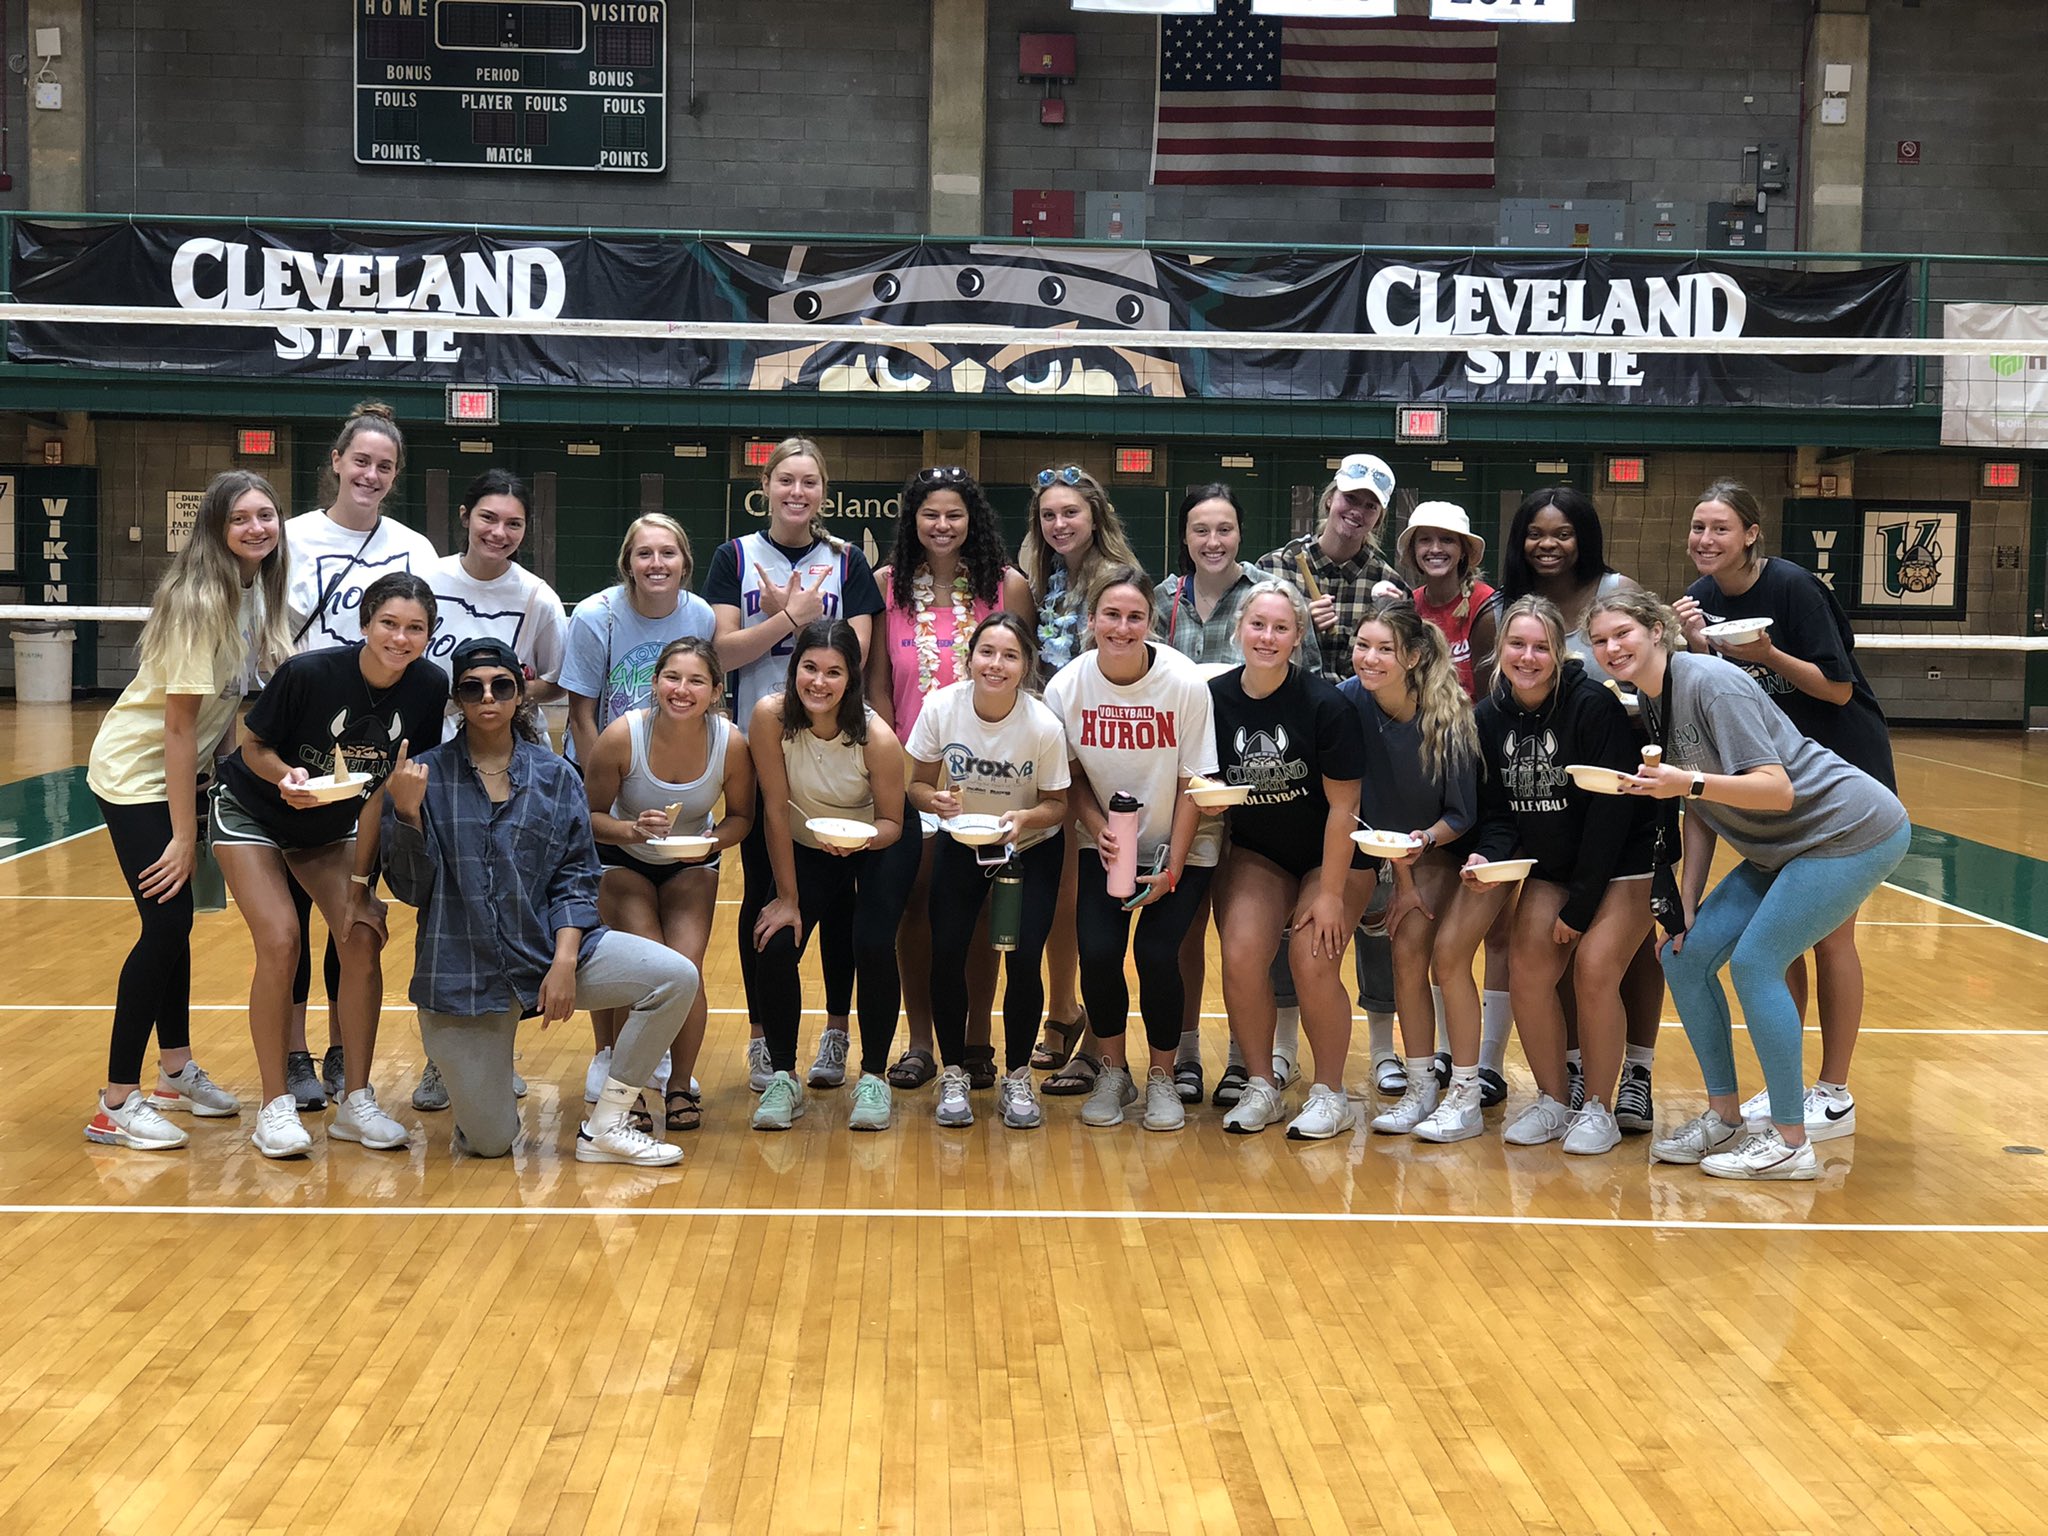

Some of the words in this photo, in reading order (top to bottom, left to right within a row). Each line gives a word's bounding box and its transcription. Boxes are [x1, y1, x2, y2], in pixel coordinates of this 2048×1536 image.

[365, 0, 428, 17] HOME
[591, 4, 660, 24] VISITOR
[386, 64, 432, 82] BONUS
[476, 68, 520, 83] PERIOD
[589, 71, 634, 87] BONUS
[375, 92, 417, 107] FOULS
[461, 94, 513, 111] PLAYER
[525, 96, 567, 112] FOULS
[603, 98, 646, 115] FOULS
[372, 144, 421, 161] POINTS
[486, 147, 532, 164] MATCH
[600, 151, 649, 168] POINTS
[171, 237, 566, 322] CLEVELAND
[1366, 265, 1747, 338] CLEVELAND
[274, 309, 462, 363] STATE
[1465, 344, 1645, 387] STATE
[460, 394, 486, 415] EXIT
[1409, 413, 1436, 433] EXIT
[42, 498, 69, 603] VIKIN
[1098, 706, 1153, 719] VOLLEYBALL
[1080, 709, 1177, 750] HURON
[299, 744, 396, 777] CLEELAN
[1226, 760, 1309, 785] CLEVELAND
[1240, 786, 1310, 806] OLLEYBALL
